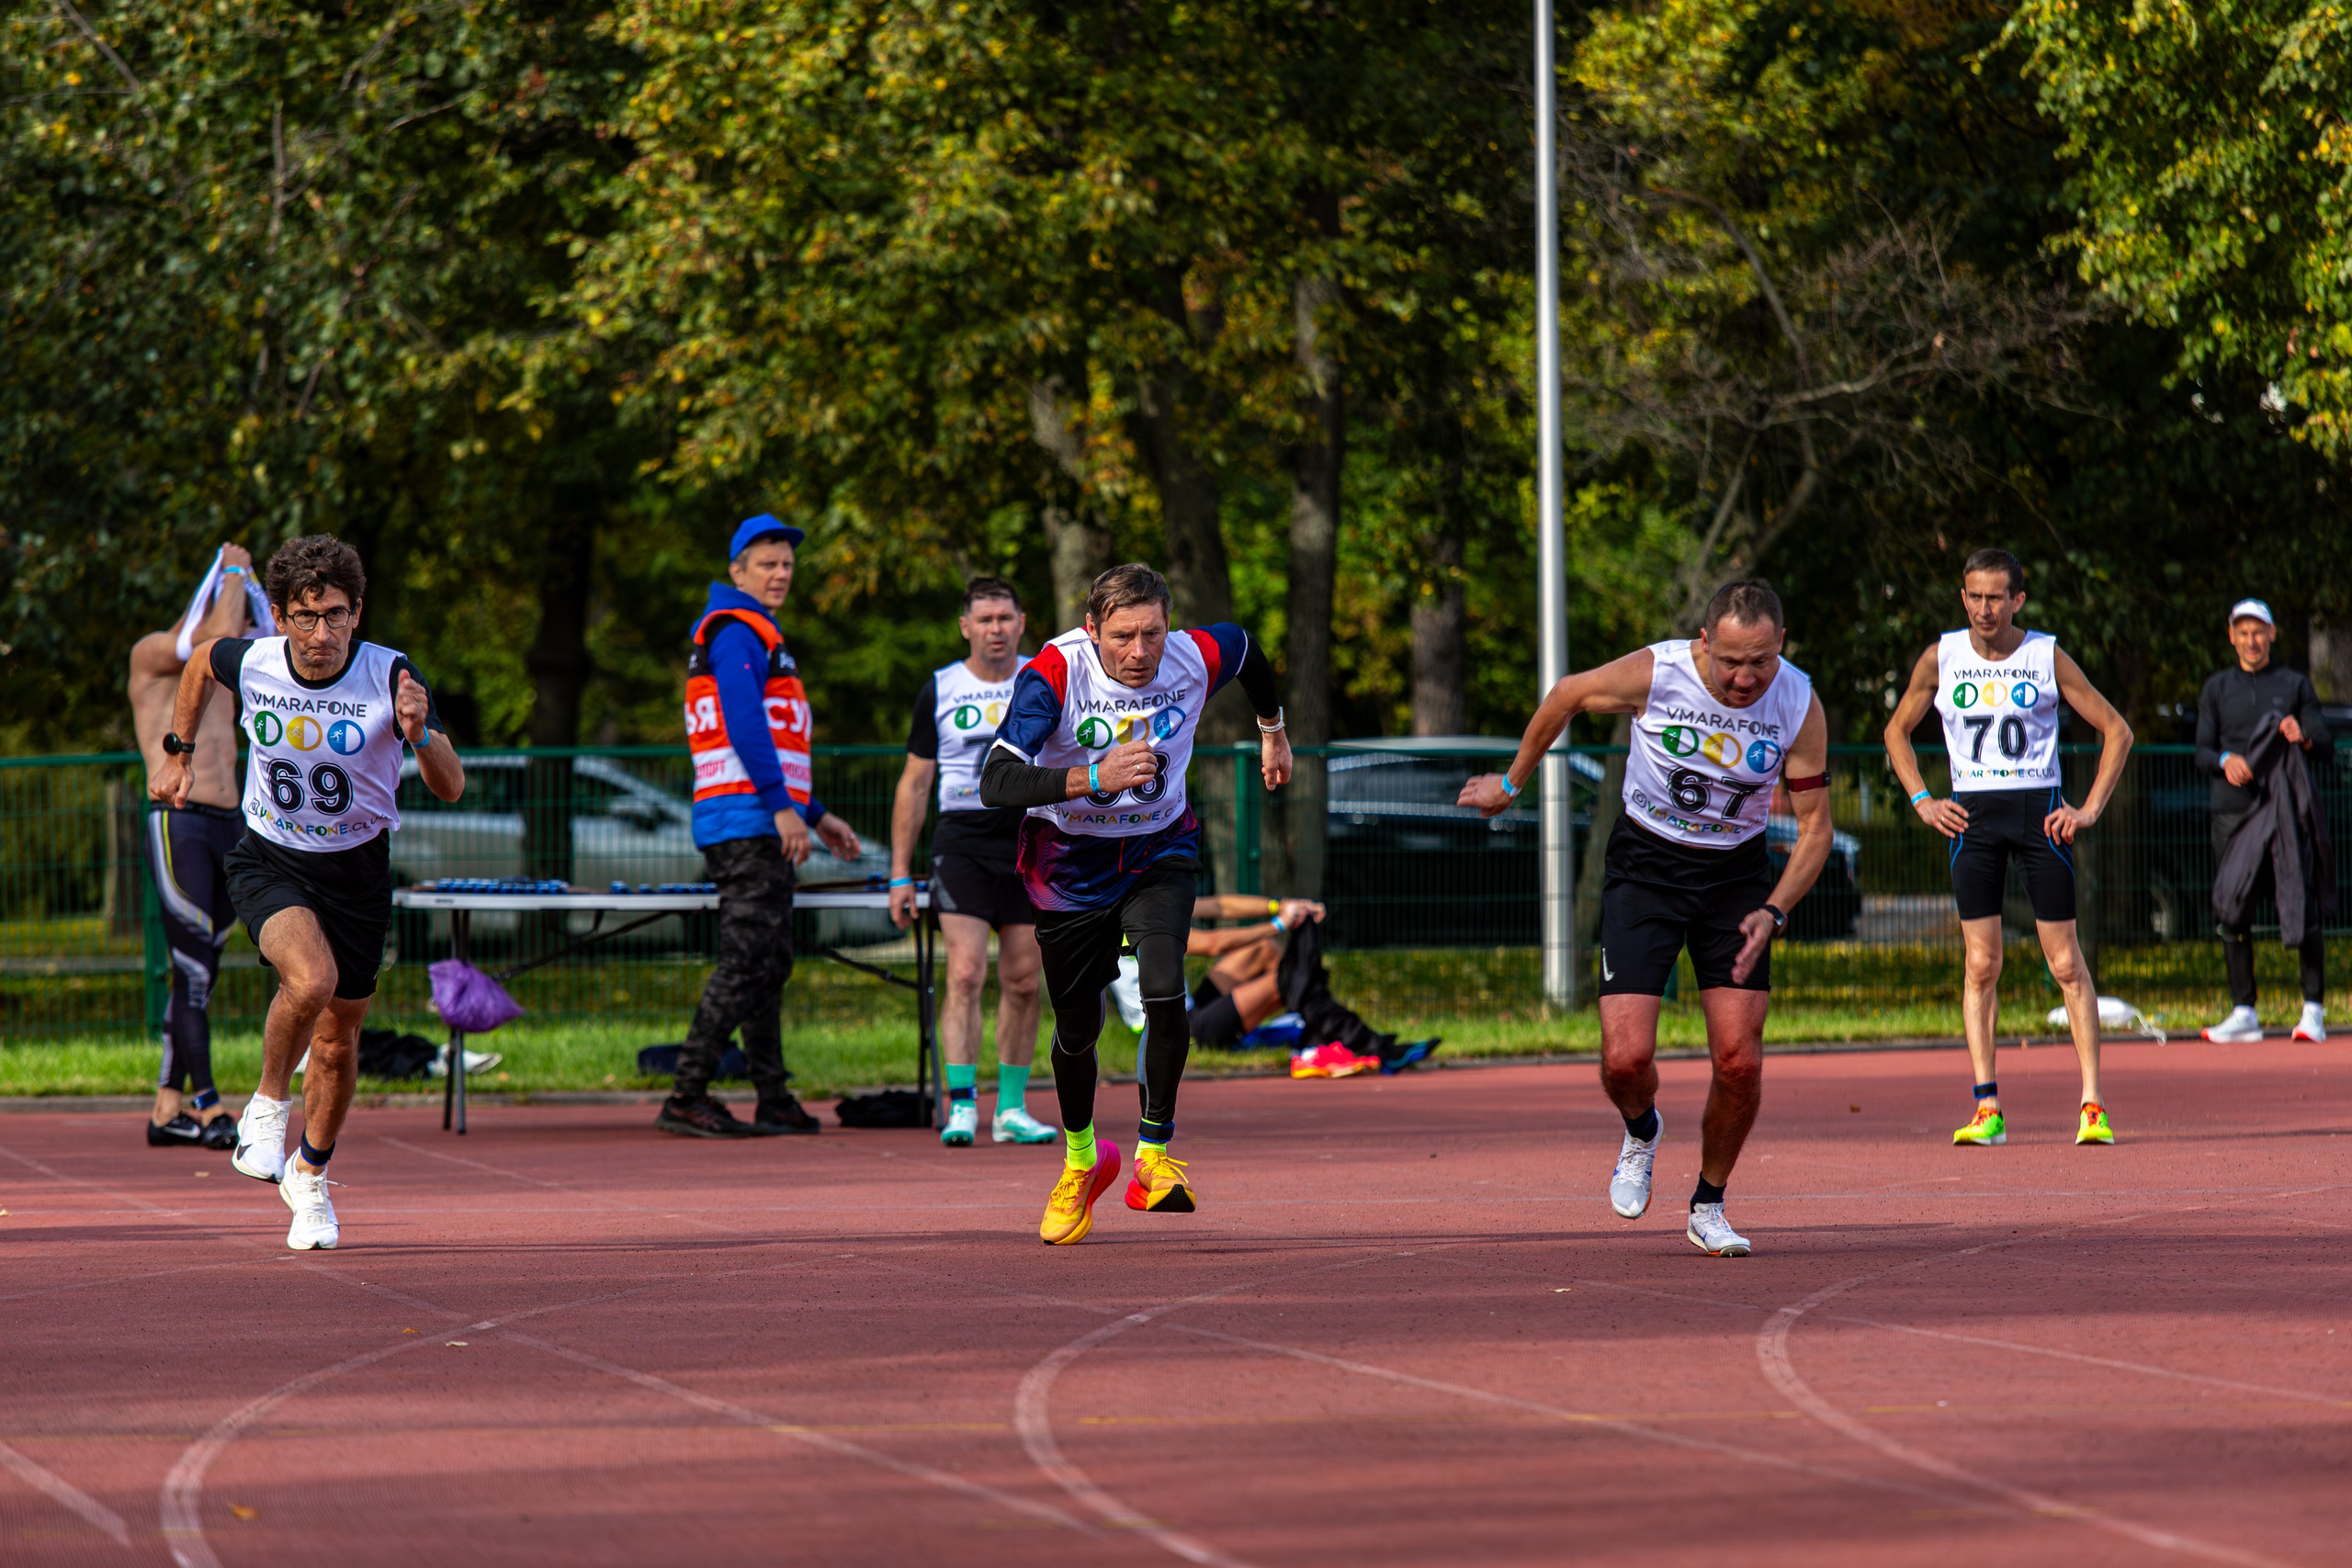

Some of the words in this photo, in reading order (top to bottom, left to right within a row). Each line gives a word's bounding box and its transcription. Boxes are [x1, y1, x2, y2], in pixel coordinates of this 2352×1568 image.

[1954, 668, 2040, 681] VMARAFONE
[252, 691, 368, 718] VMARAFONE
[954, 690, 1014, 705] VMARAF
[1078, 688, 1187, 713] VMARAFONE
[1667, 706, 1781, 740] VMARAFONE
[1962, 714, 2029, 763] 70
[963, 734, 996, 780] 7
[266, 758, 354, 817] 69
[1667, 766, 1770, 820] 67
